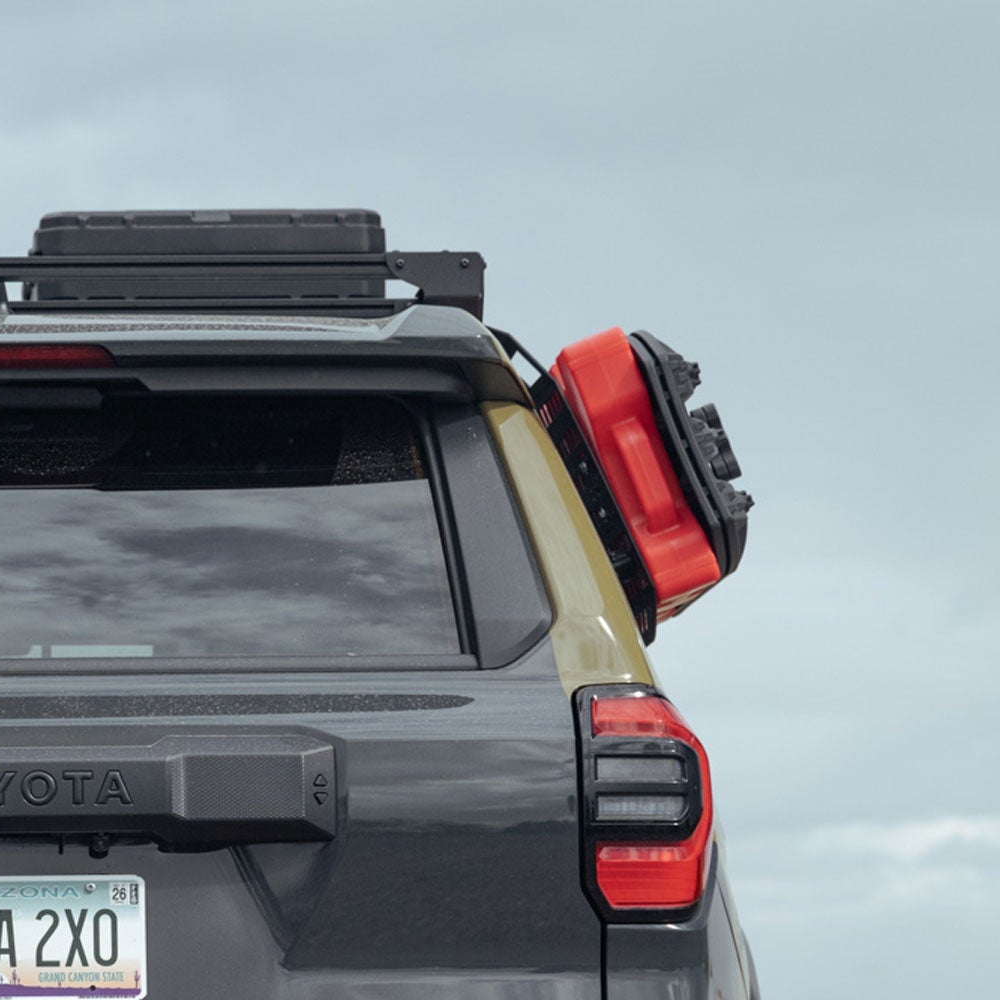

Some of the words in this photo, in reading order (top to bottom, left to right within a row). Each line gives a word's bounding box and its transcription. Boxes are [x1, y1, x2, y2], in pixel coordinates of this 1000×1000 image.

[112, 887, 127, 901] 26
[38, 971, 66, 983] GRAND
[68, 971, 101, 983] CANYON
[102, 971, 125, 983] STATE
